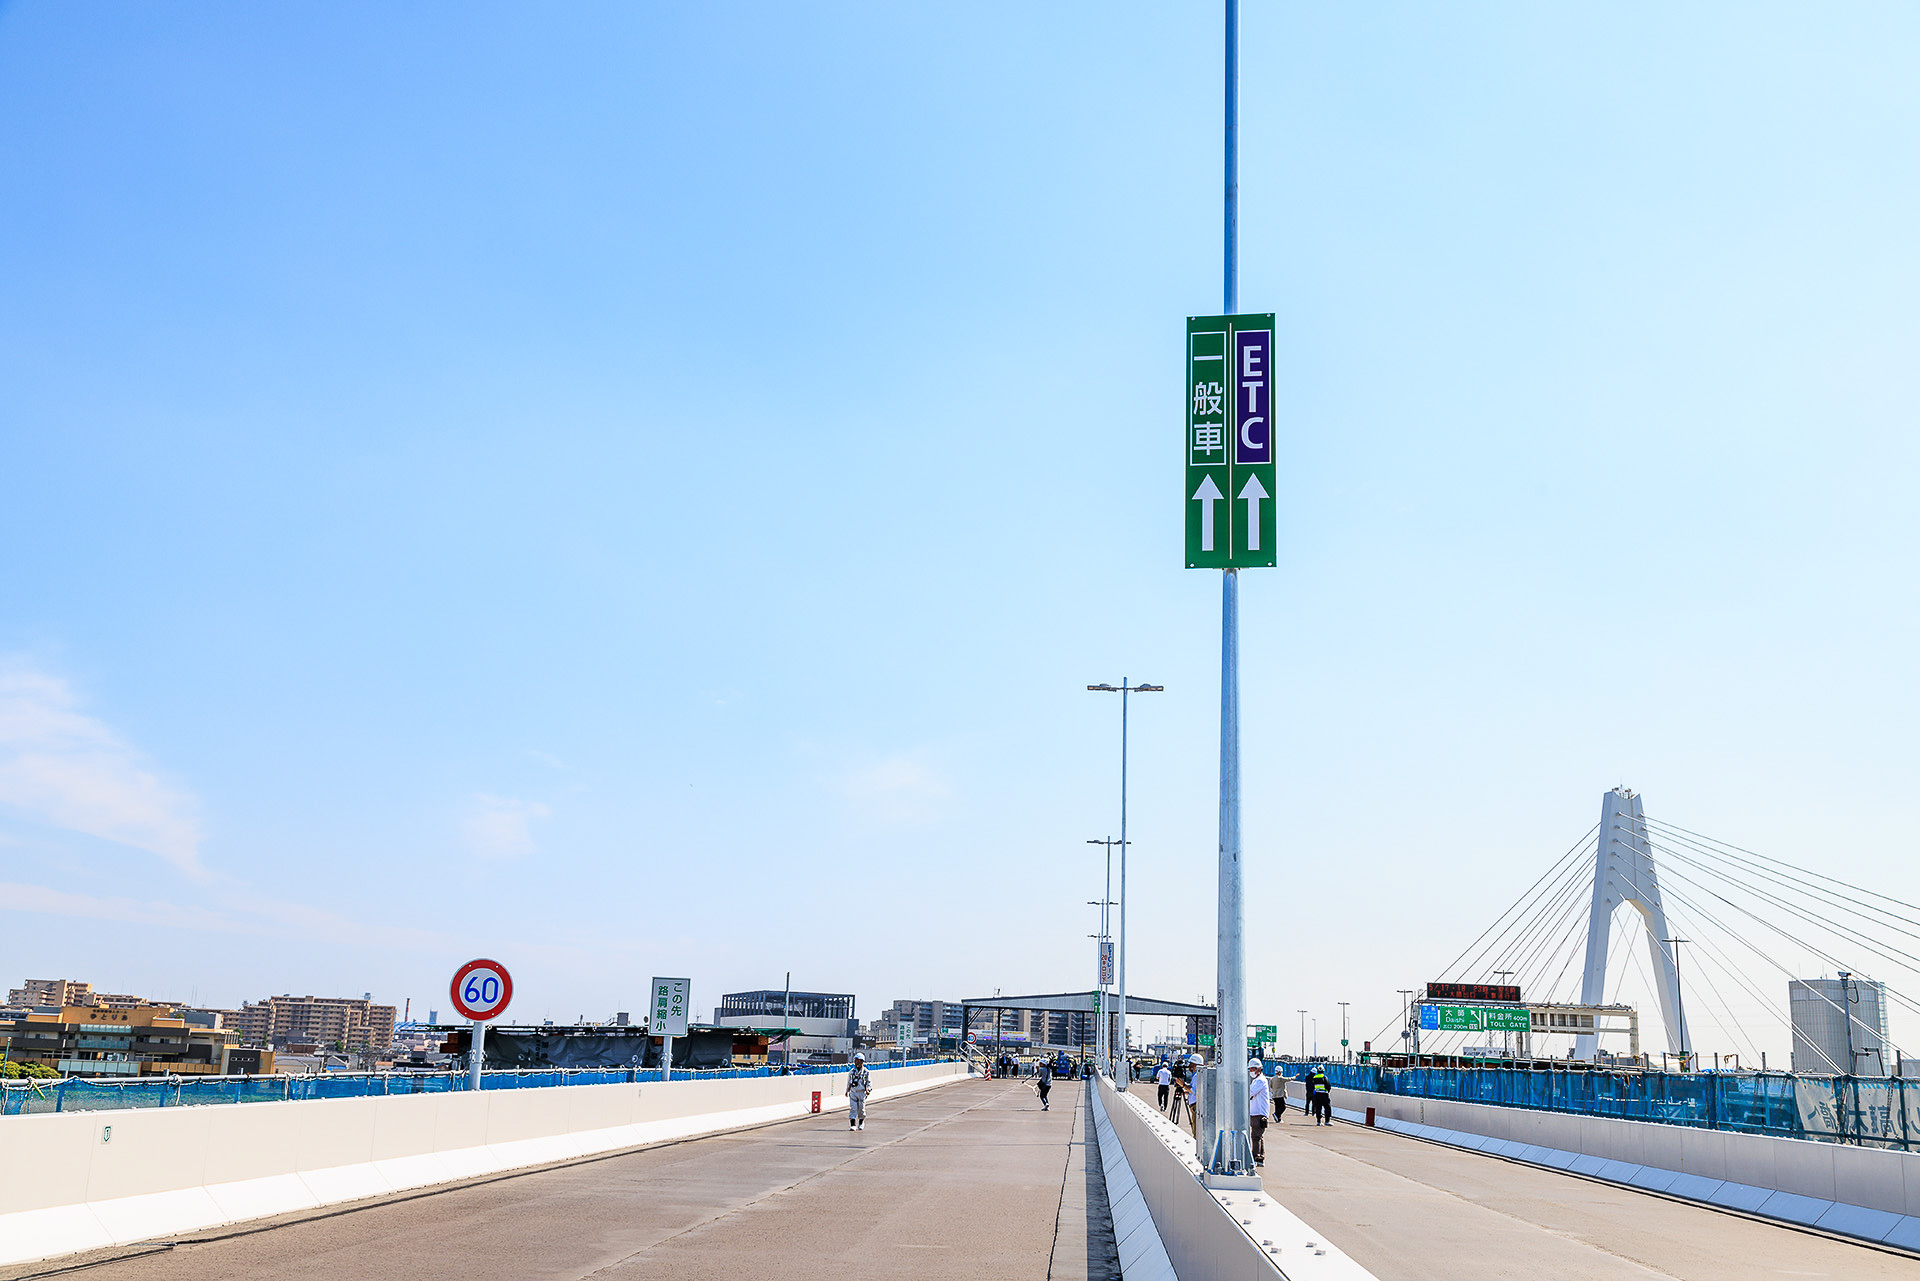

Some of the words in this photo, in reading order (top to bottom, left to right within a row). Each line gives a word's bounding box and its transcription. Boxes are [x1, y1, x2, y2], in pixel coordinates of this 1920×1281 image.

[1193, 354, 1223, 456] 一般車
[1241, 345, 1264, 449] ETC
[464, 976, 499, 1004] 60
[655, 985, 669, 1032] 路肩縮小
[671, 982, 683, 1017] この先
[1488, 1012, 1512, 1021] 料金所
